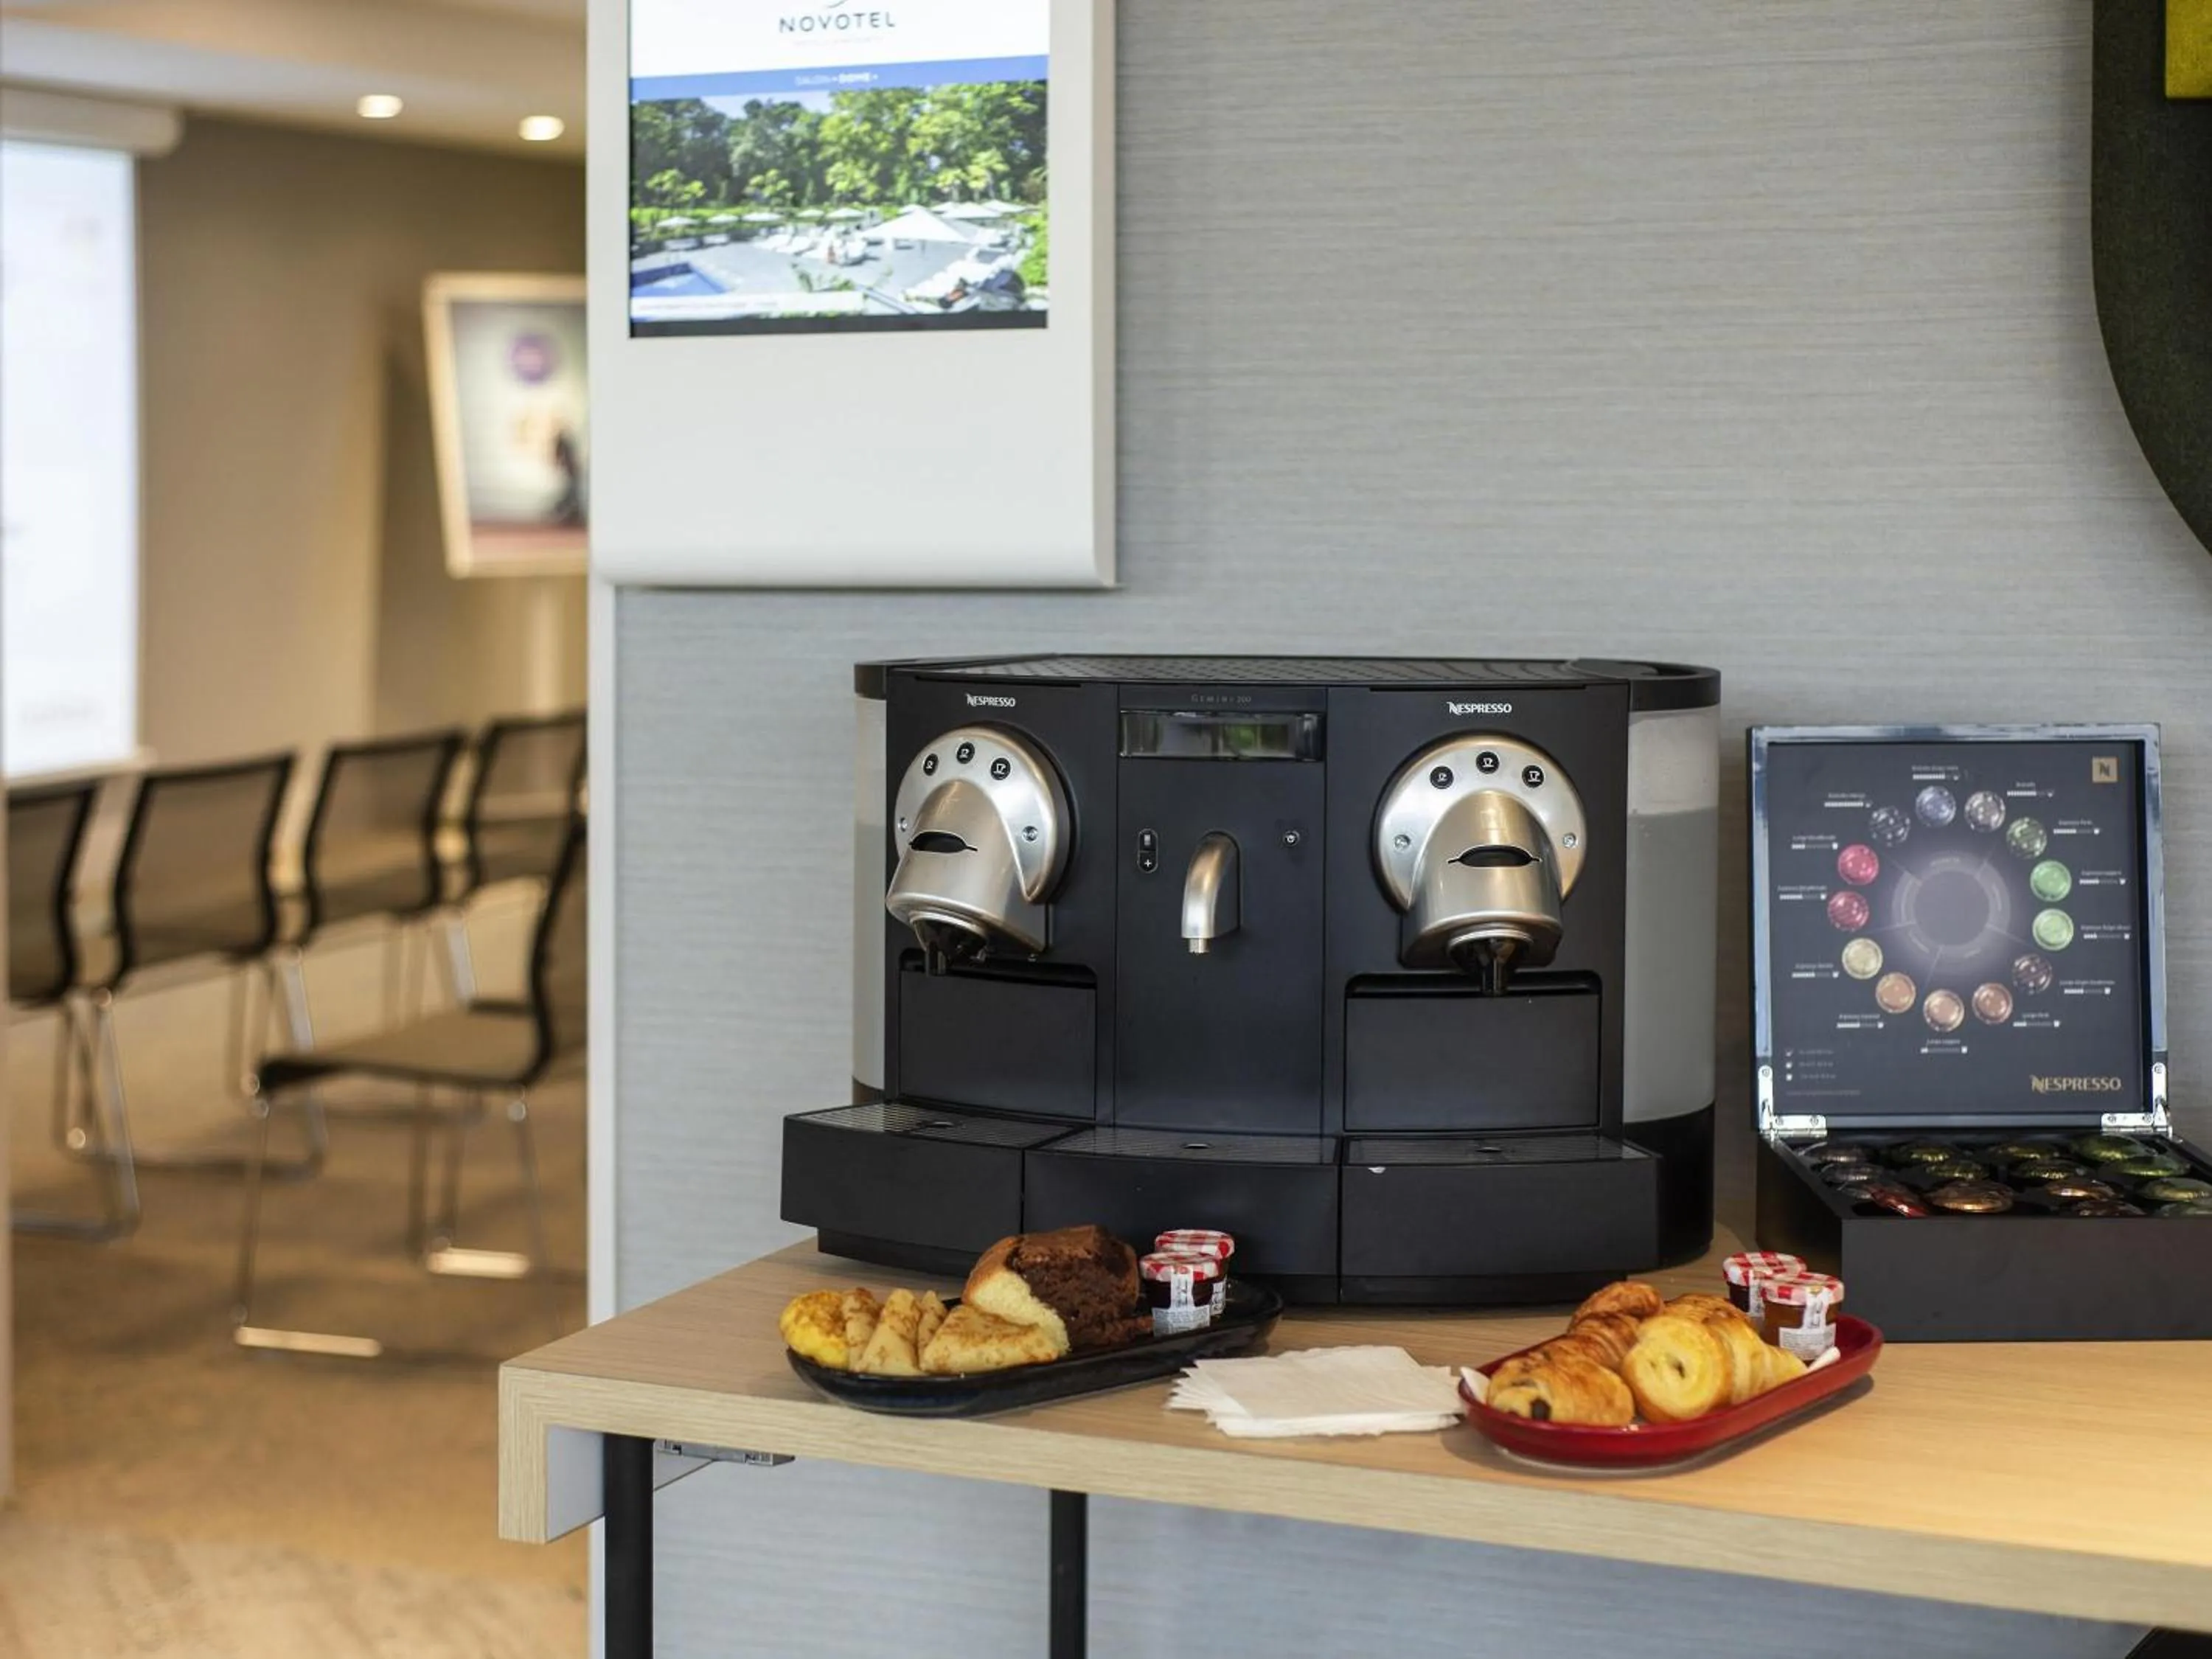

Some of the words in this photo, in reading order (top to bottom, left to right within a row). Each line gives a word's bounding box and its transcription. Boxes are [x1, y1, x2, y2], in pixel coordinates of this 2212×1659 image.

[779, 12, 895, 33] NOVOTEL
[965, 692, 1016, 707] NESPRESSO
[1447, 702, 1512, 715] NESPRESSO
[2029, 1074, 2122, 1094] NESPRESSO
